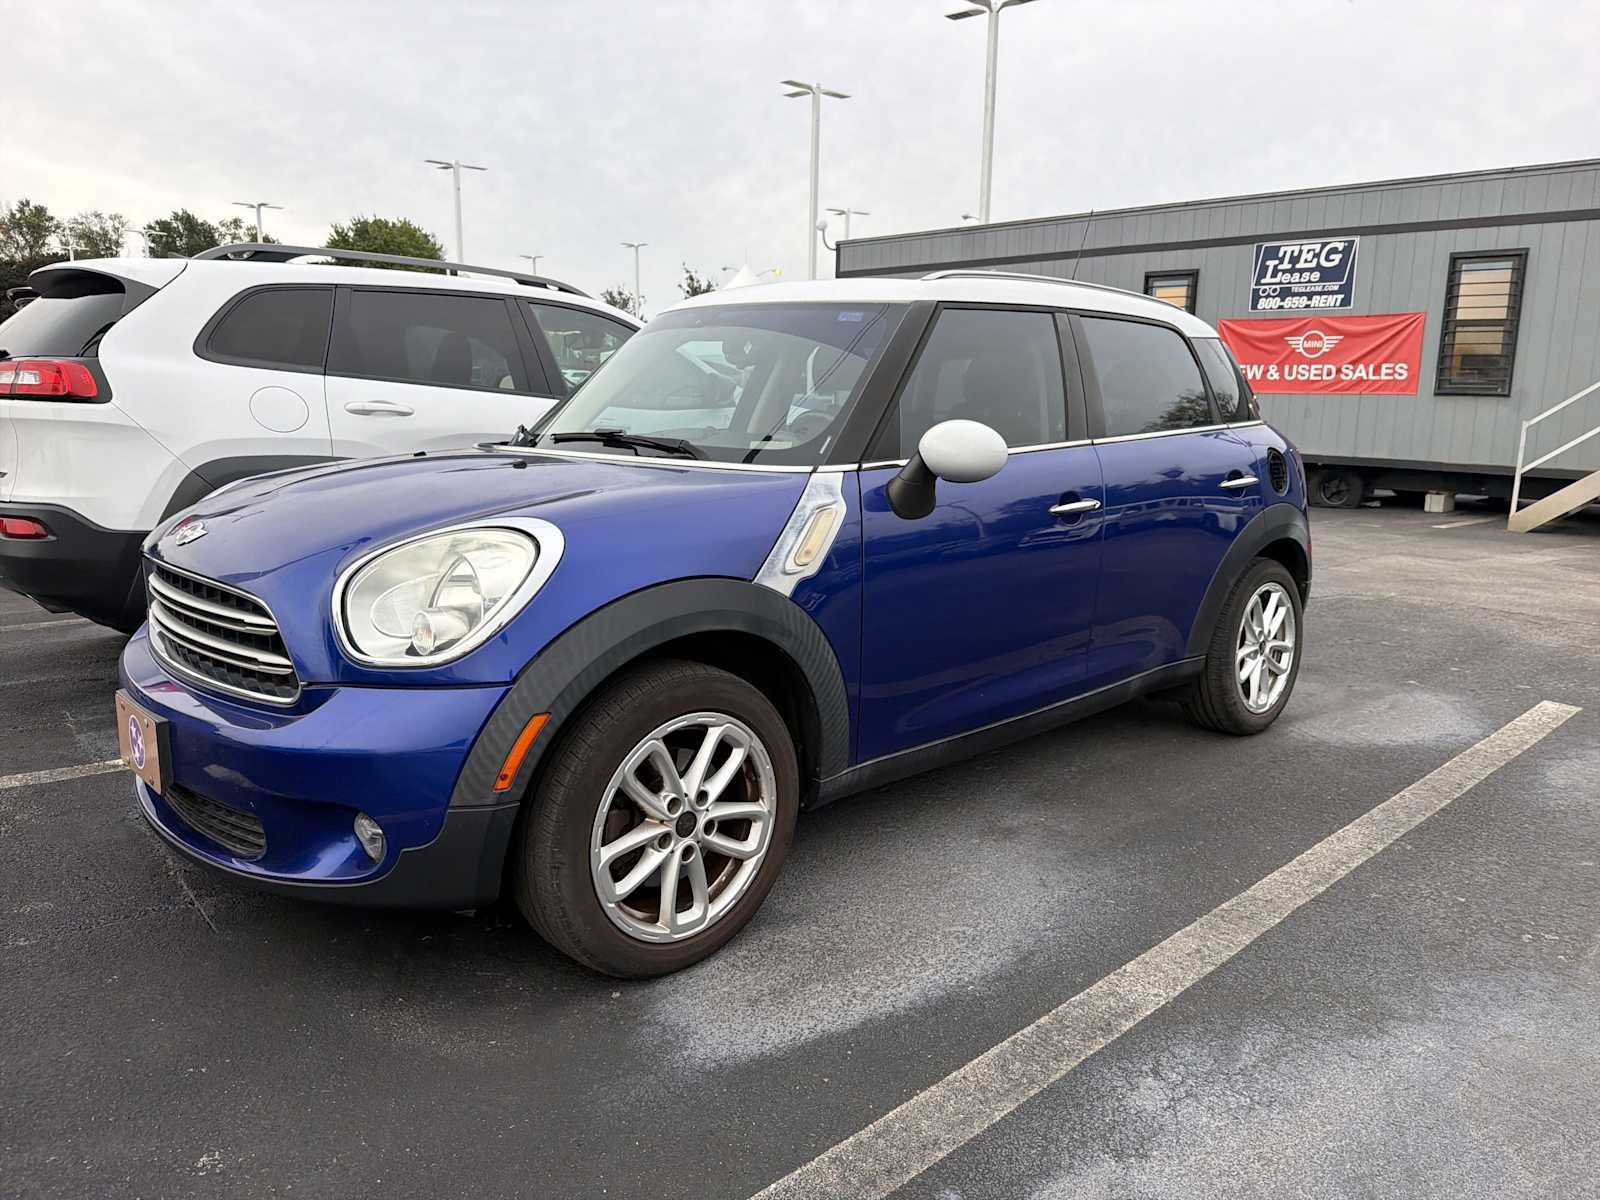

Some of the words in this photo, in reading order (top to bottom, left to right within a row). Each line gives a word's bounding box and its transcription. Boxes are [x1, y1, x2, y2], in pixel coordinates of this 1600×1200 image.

[1278, 241, 1345, 270] TEG
[1260, 259, 1321, 284] Lease
[1257, 294, 1345, 310] 800-659-RENT
[1303, 340, 1324, 348] MINI
[1239, 364, 1265, 380] EW
[1266, 364, 1280, 381] &
[1284, 364, 1337, 381] USED
[1340, 363, 1409, 381] SALES
